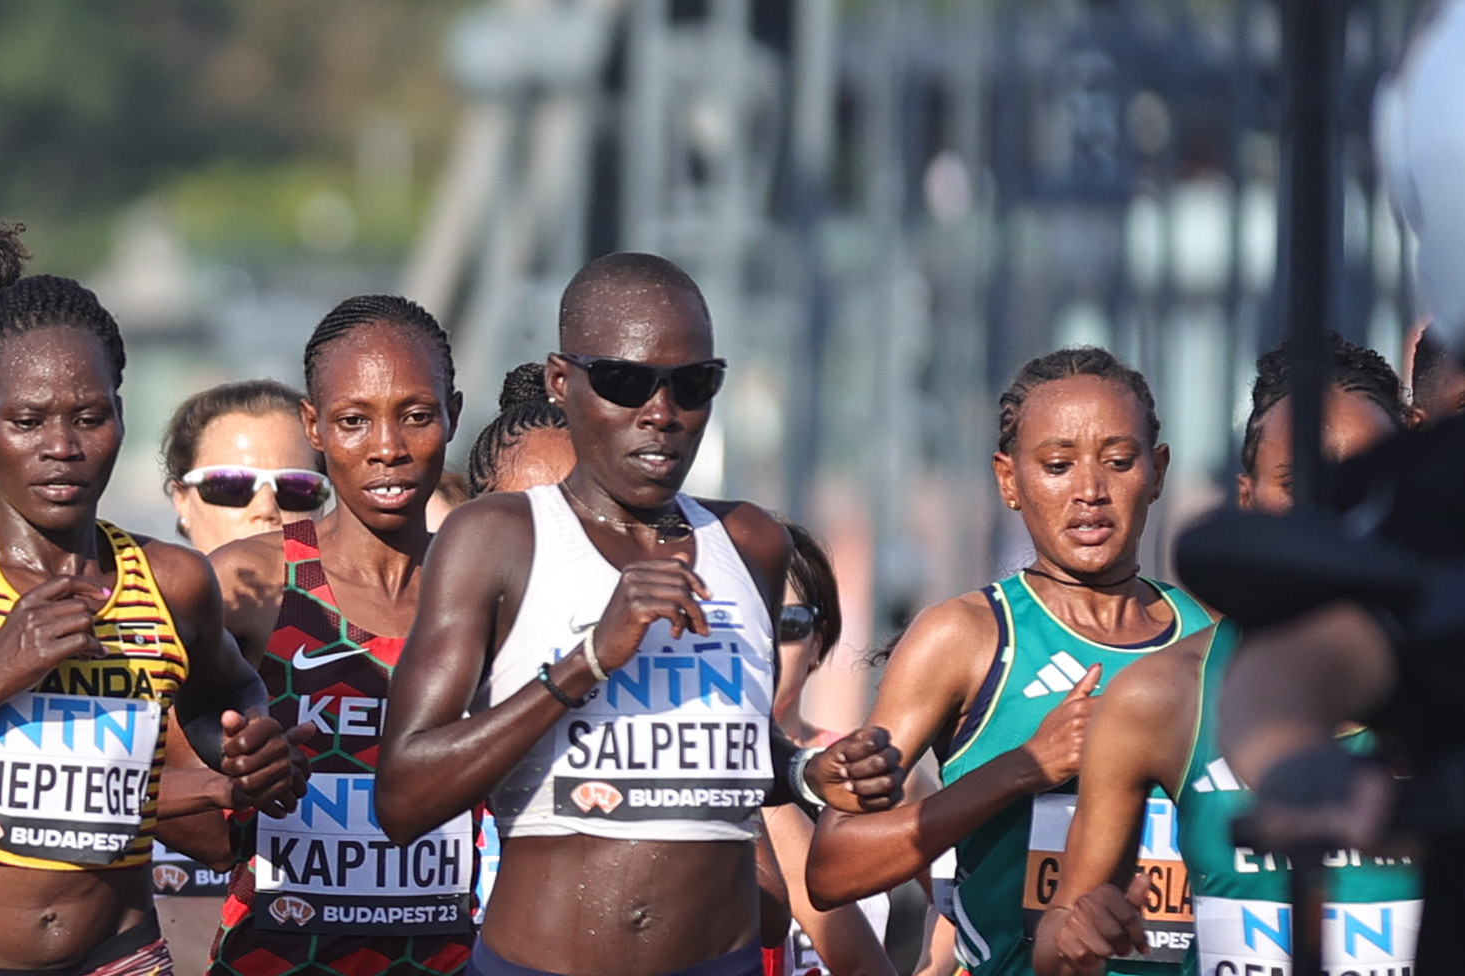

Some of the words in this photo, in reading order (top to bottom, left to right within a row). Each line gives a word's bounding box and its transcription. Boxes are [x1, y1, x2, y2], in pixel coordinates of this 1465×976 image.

[31, 666, 155, 699] ANDA
[606, 655, 744, 710] NTN
[567, 720, 760, 770] SALPETER
[628, 788, 743, 807] BUDAPEST
[744, 789, 765, 807] 23
[10, 826, 129, 852] BUDAPEST
[270, 836, 460, 888] KAPTICH
[323, 906, 436, 924] BUDAPEST
[438, 905, 458, 922] 23
[1241, 905, 1394, 959] NN
